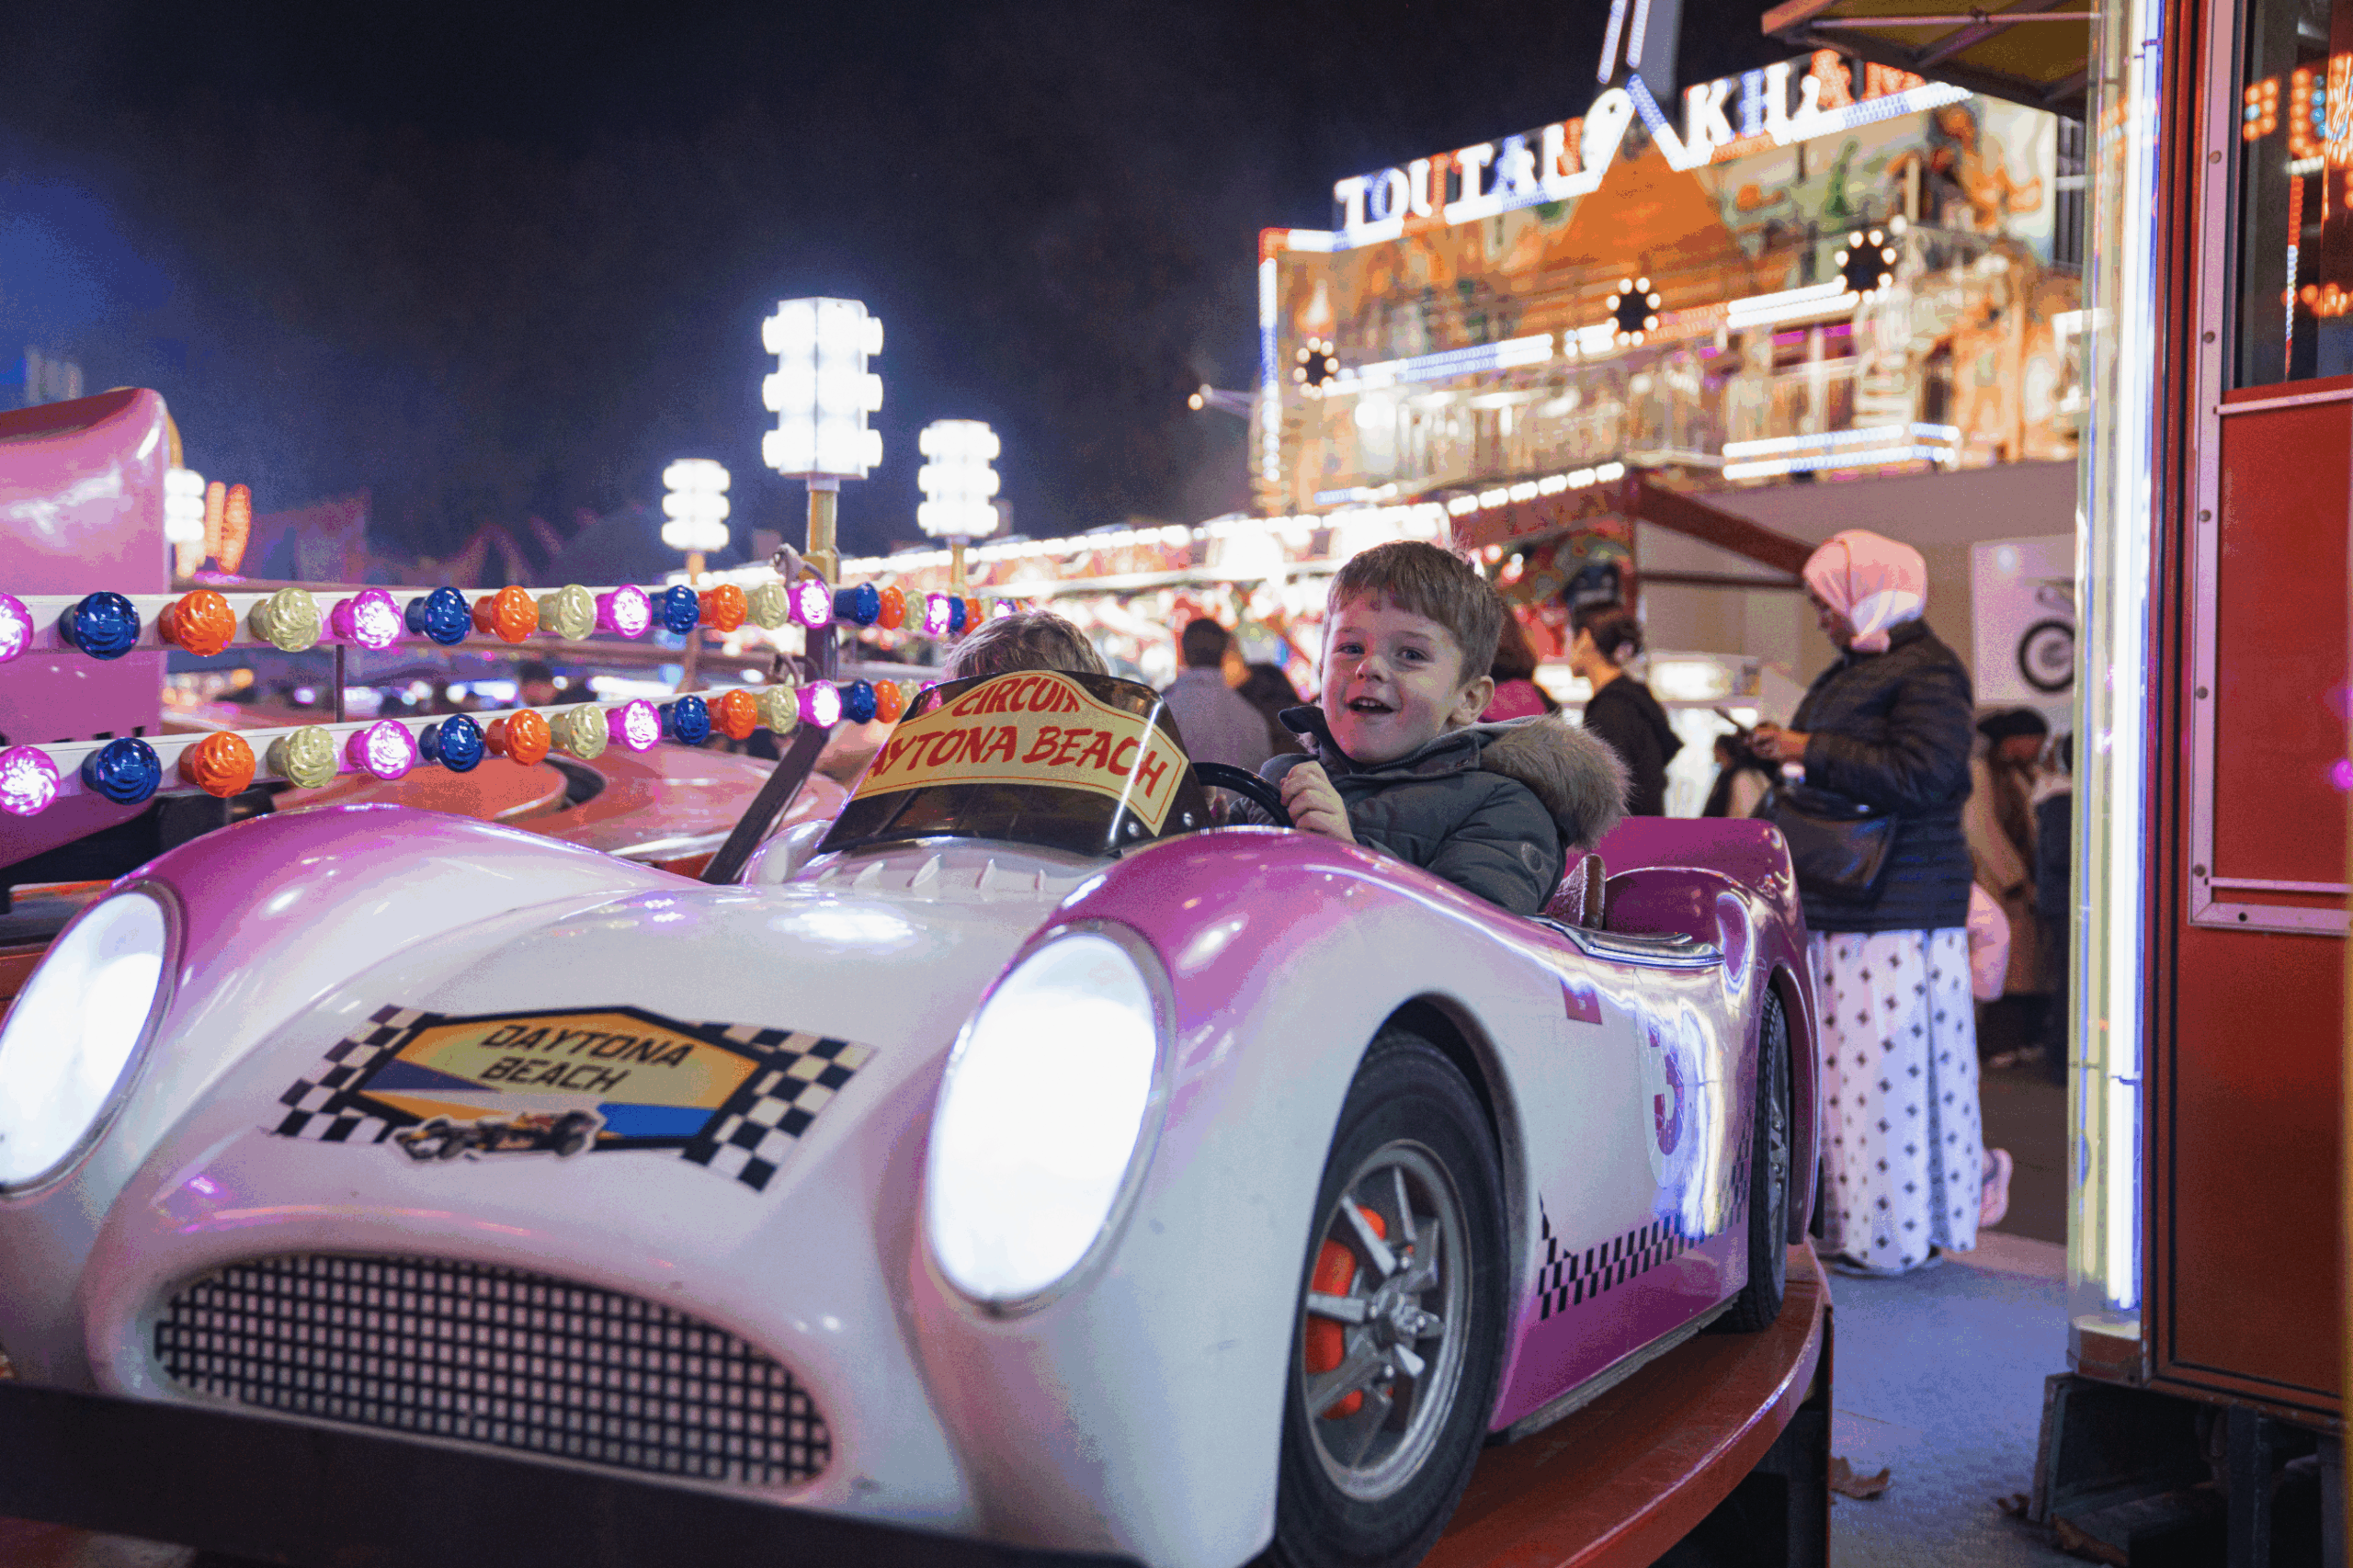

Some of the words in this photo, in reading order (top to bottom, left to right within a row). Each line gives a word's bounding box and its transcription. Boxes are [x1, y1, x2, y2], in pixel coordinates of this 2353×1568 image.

[950, 676, 1081, 717] CIRCUIT
[1022, 726, 1168, 799] BEACH
[480, 1024, 696, 1069] DAYTONA
[479, 1056, 632, 1094] BEACH
